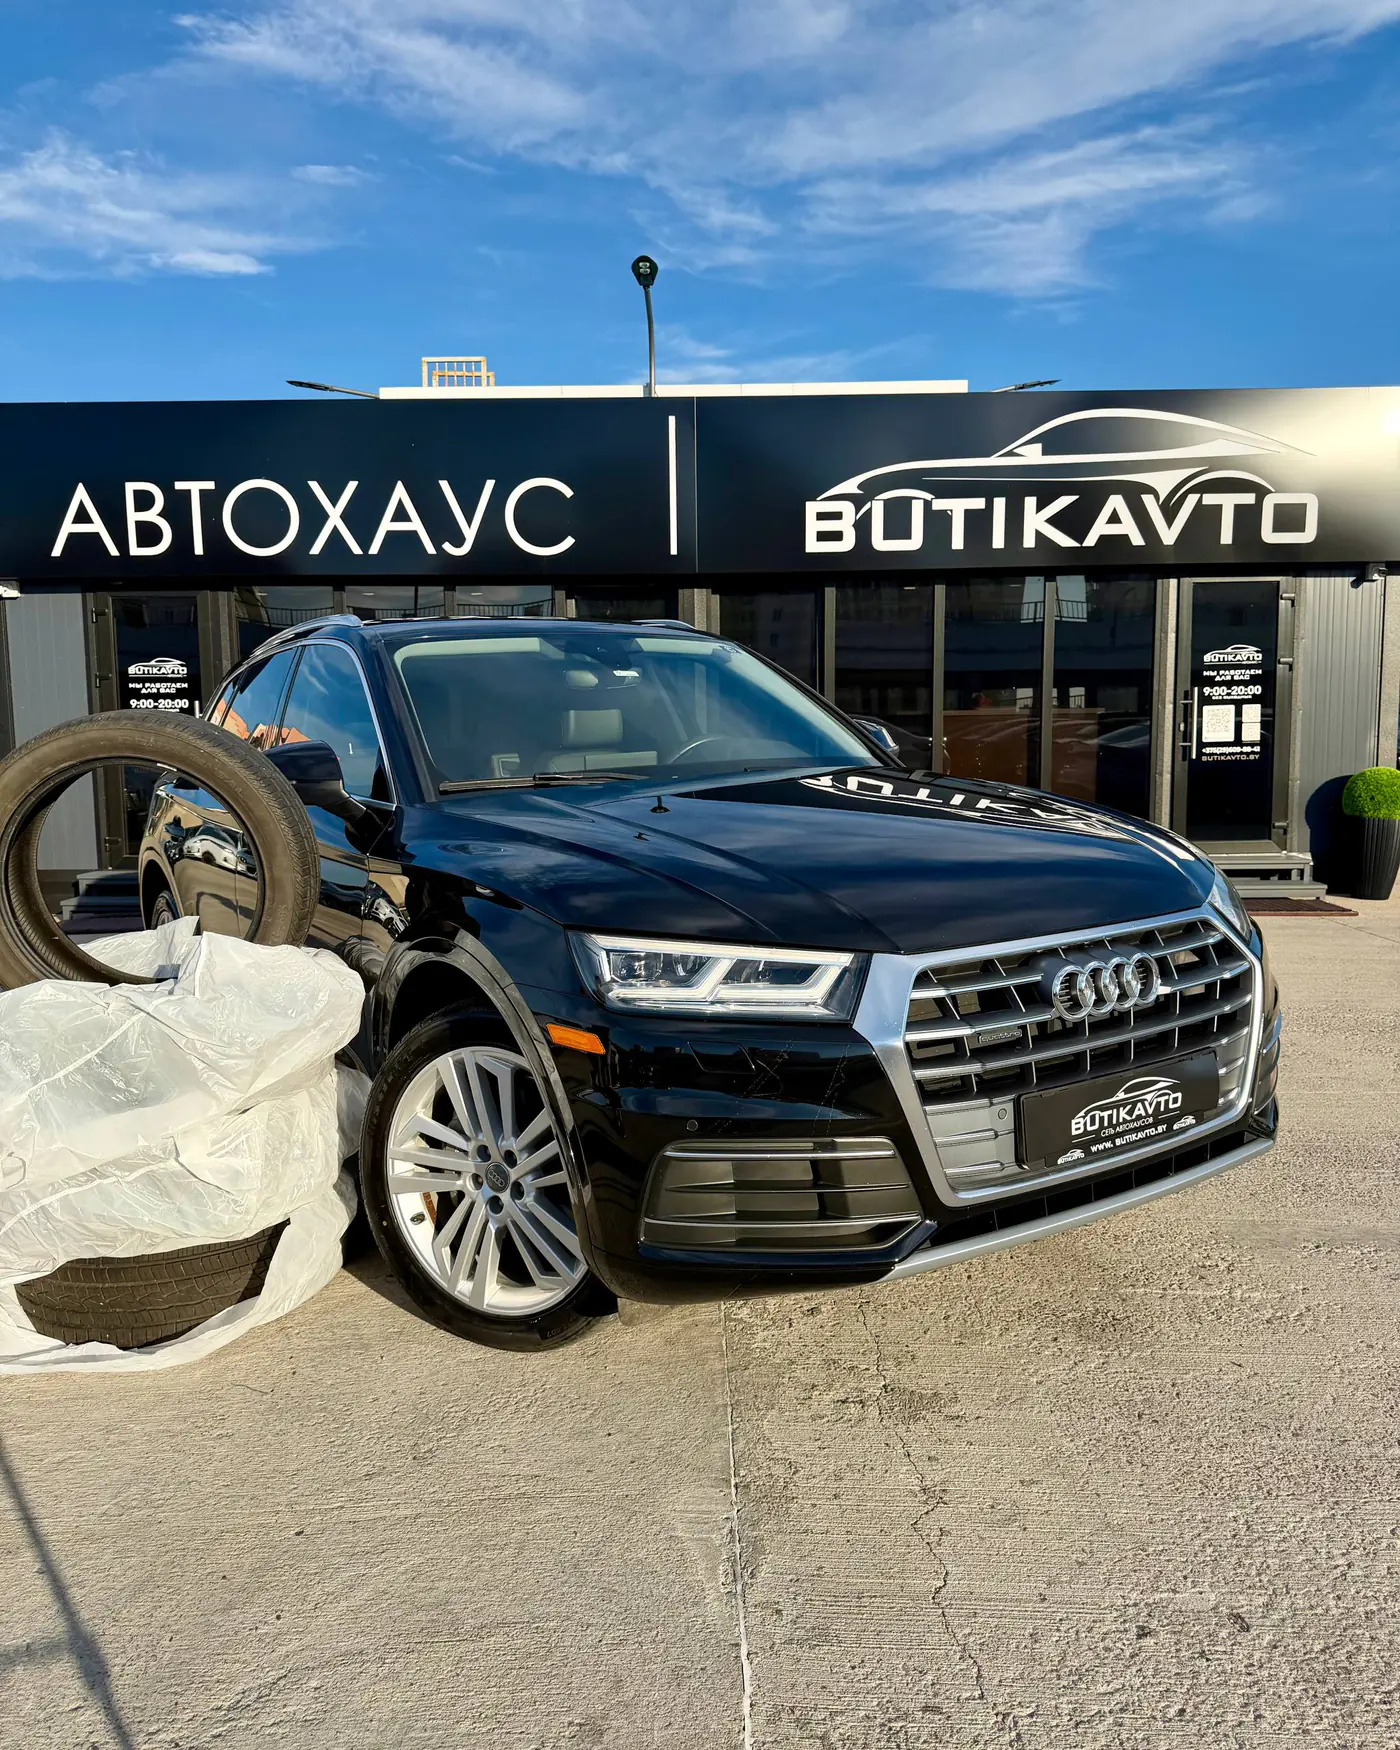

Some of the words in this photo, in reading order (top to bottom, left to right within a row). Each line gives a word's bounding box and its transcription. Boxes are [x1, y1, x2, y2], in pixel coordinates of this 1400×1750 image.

[51, 477, 577, 557] АВТОХАУС
[805, 492, 1319, 553] BUTIKAVTO
[1203, 653, 1263, 662] BUTIKAVTO
[128, 666, 187, 675] BUTIKAVTO
[1203, 685, 1262, 696] 9:00-20:00
[129, 699, 189, 708] 9:00-20:00
[1071, 1092, 1182, 1136] BUTIKAVTO
[1101, 1127, 1115, 1137] СЕТЬ
[1115, 1117, 1154, 1133] АВТОХАУСОВ
[1090, 1140, 1114, 1153] WWW.
[1115, 1124, 1168, 1146] BUTIKAVTO.BY
